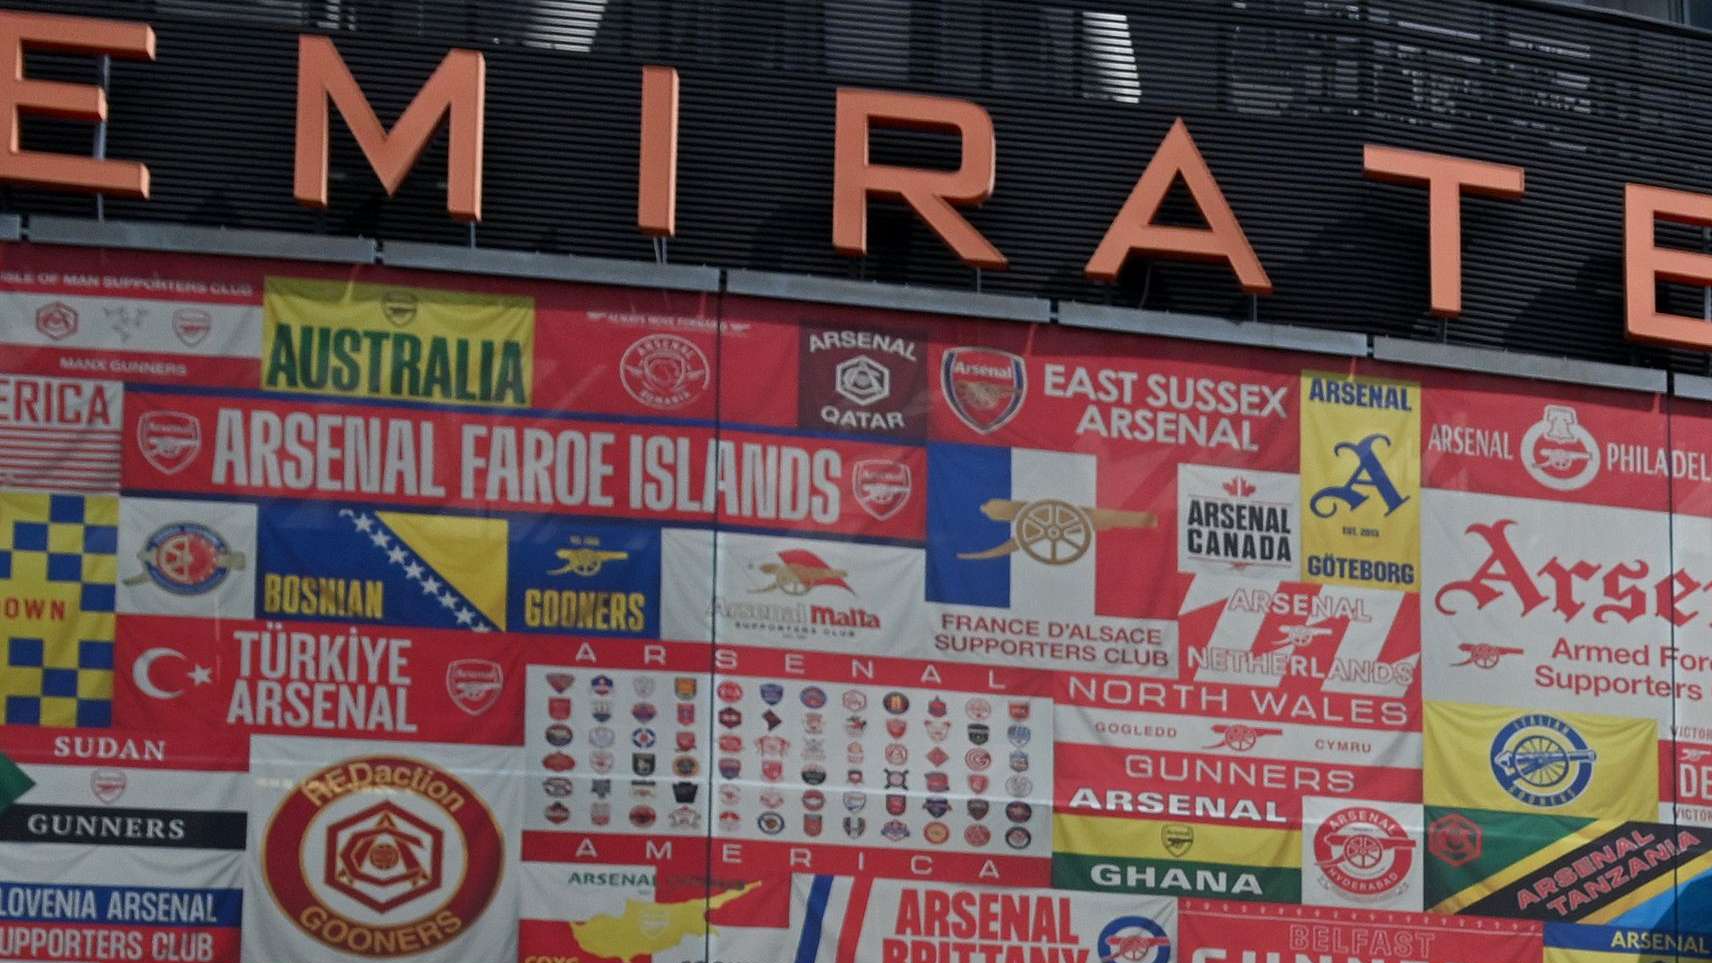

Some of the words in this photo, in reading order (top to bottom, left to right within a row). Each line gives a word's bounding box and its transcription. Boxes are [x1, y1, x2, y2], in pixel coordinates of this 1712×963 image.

[809, 330, 918, 363] ARSENAL
[266, 323, 528, 405] AUSTRALIA
[1044, 363, 1140, 401] EAST
[1145, 372, 1289, 418] SUSSEX
[1309, 378, 1412, 413] ARSENAL
[821, 405, 905, 432] QATAR
[1076, 407, 1259, 452] ARSENAL
[212, 408, 446, 497] ARSENAL
[461, 423, 614, 509] FAROE
[629, 435, 844, 524] ISLANDS
[1187, 499, 1291, 534] ARSENAL
[1187, 528, 1292, 562] CANADA
[1308, 554, 1415, 586] GÖTEBORG
[941, 613, 1040, 639] FRANCE
[1048, 617, 1163, 646] D'ALSACE
[934, 634, 1095, 662] SUPPORTERS
[1104, 645, 1169, 668] CLUB
[1551, 637, 1650, 668] Armed
[1534, 664, 1702, 699] Supporters
[228, 680, 417, 732] ARSENAL
[1068, 675, 1229, 712] NORTH
[1251, 692, 1409, 725] WALES
[1094, 720, 1178, 738] GOGLEDD
[1314, 738, 1372, 754] CYMRU
[55, 736, 166, 762] SUDAN
[1125, 754, 1356, 793] GUNNERS
[1068, 787, 1288, 822] ARSENAL
[27, 813, 186, 840] GUNNERS
[1090, 863, 1263, 895] GHANA
[1610, 930, 1711, 955] ARSENAL
